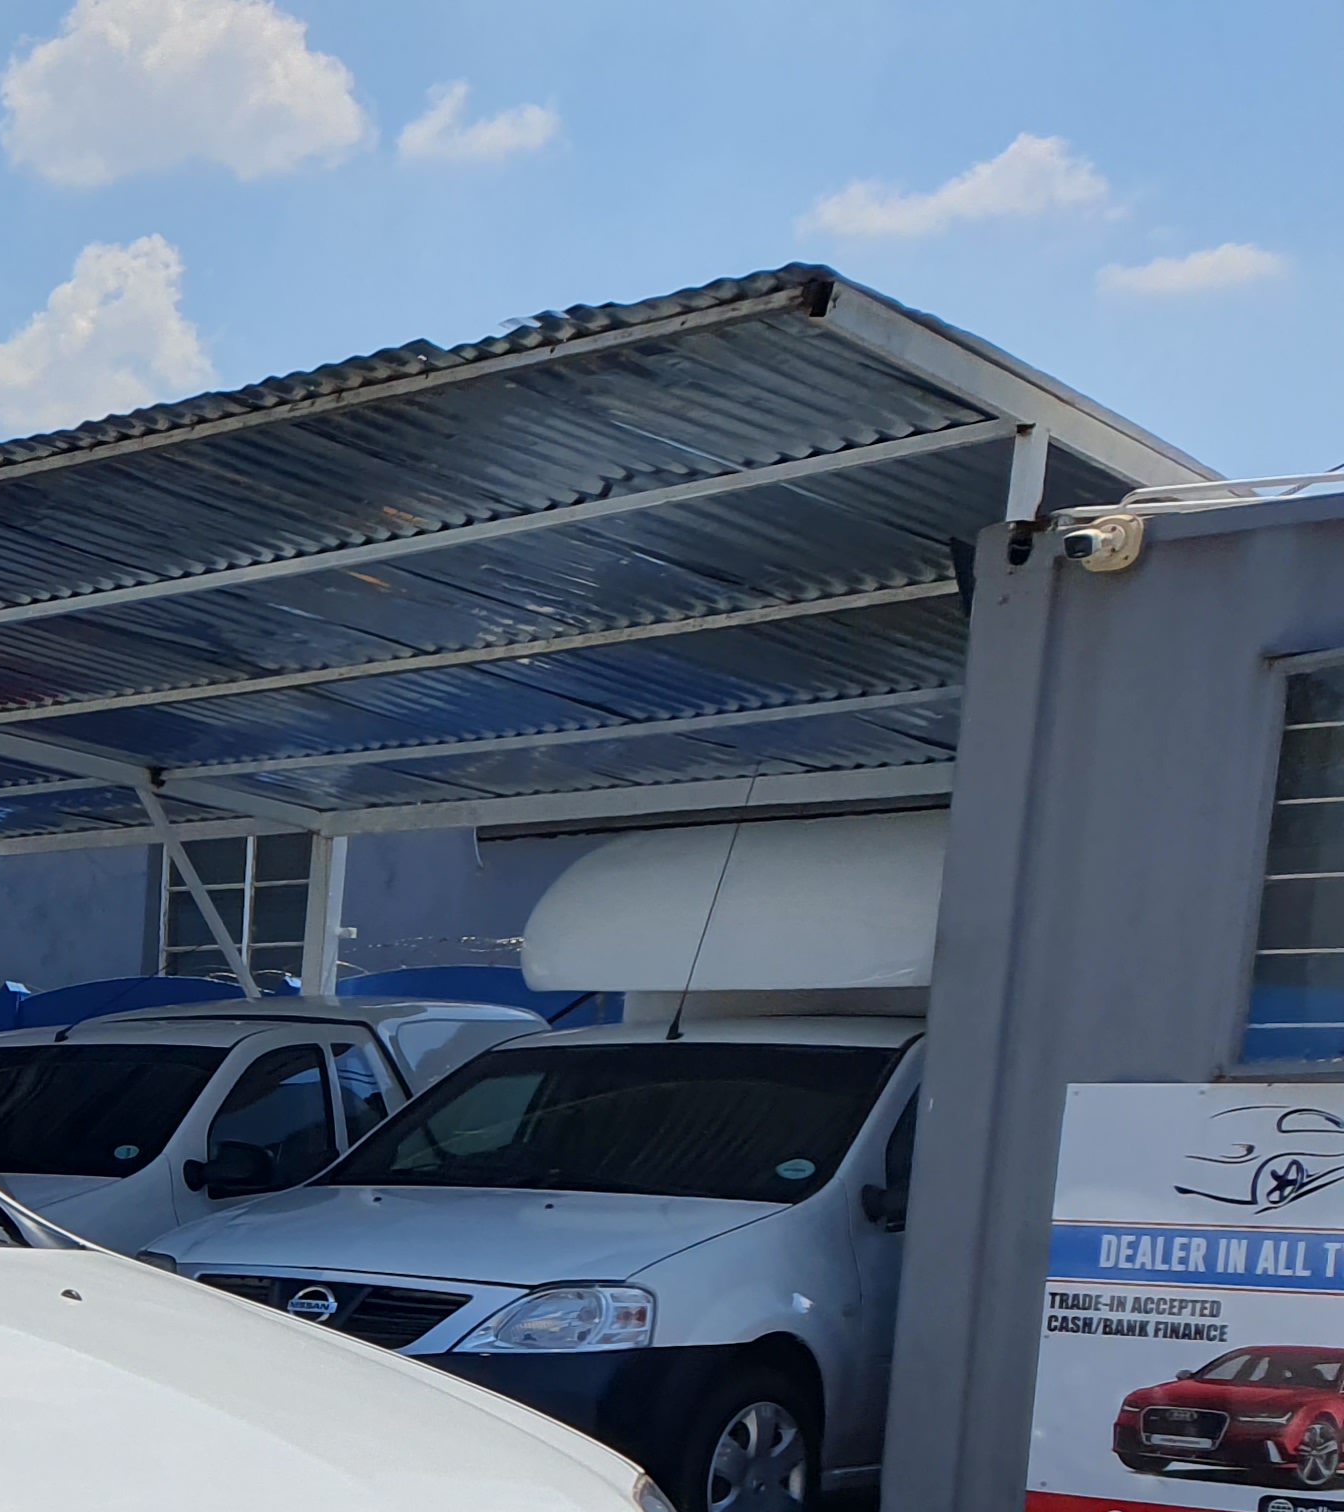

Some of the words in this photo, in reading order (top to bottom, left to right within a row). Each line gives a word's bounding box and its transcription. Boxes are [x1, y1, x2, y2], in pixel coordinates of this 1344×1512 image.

[1099, 1234, 1207, 1272] DEALER
[1216, 1238, 1248, 1274] IN
[1255, 1239, 1312, 1277] ALL
[1323, 1242, 1344, 1278] T
[290, 1301, 330, 1311] NISSAN
[1048, 1292, 1128, 1313] TRADE-IN
[1130, 1296, 1223, 1318] ACCEPTED
[1046, 1314, 1150, 1338] CASH/BANK
[1153, 1320, 1229, 1342] FINANCE
